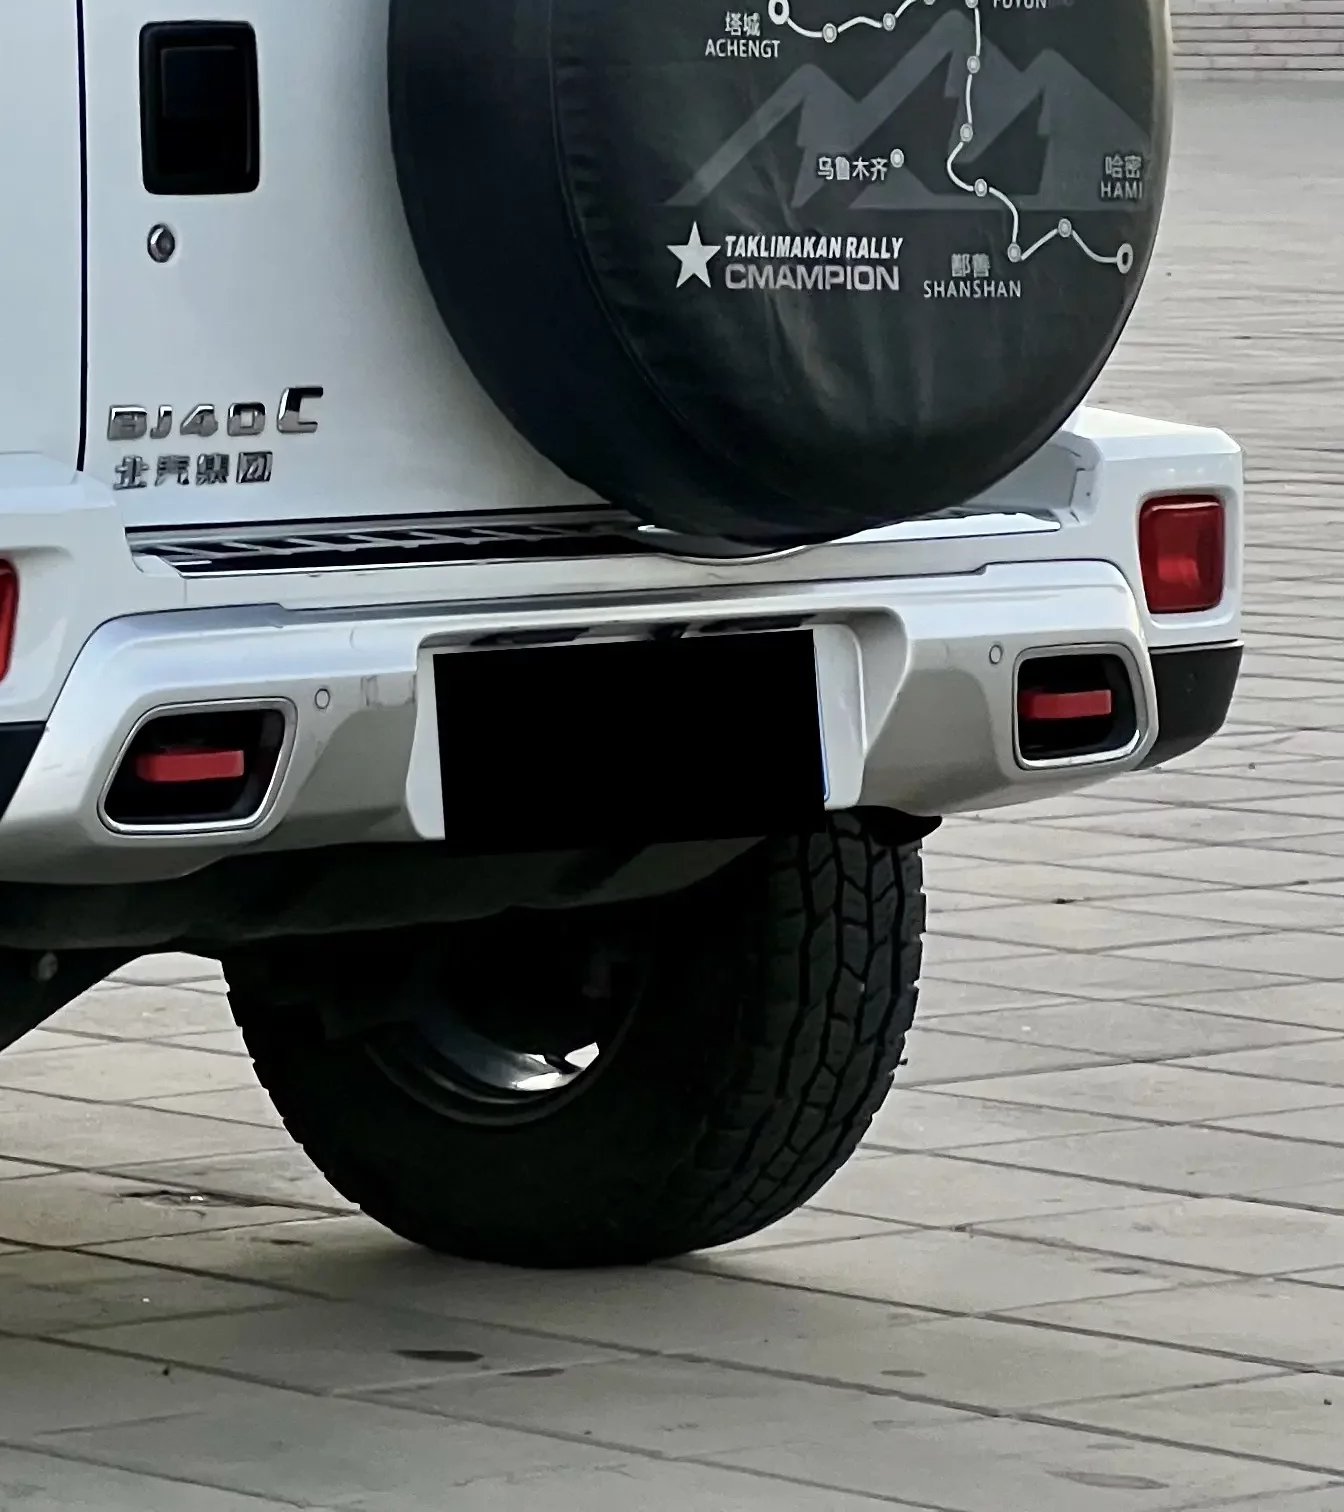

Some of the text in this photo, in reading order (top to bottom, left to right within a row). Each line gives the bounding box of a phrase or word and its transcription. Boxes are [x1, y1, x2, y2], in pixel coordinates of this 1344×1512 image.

[724, 11, 761, 37] 塔城
[704, 38, 781, 59] ACHENGT
[1104, 154, 1142, 179] 哈密
[1099, 180, 1144, 200] HAMI
[724, 235, 904, 260] TAKLIMAKAN RALLY
[923, 279, 1022, 299] SHANSHAN
